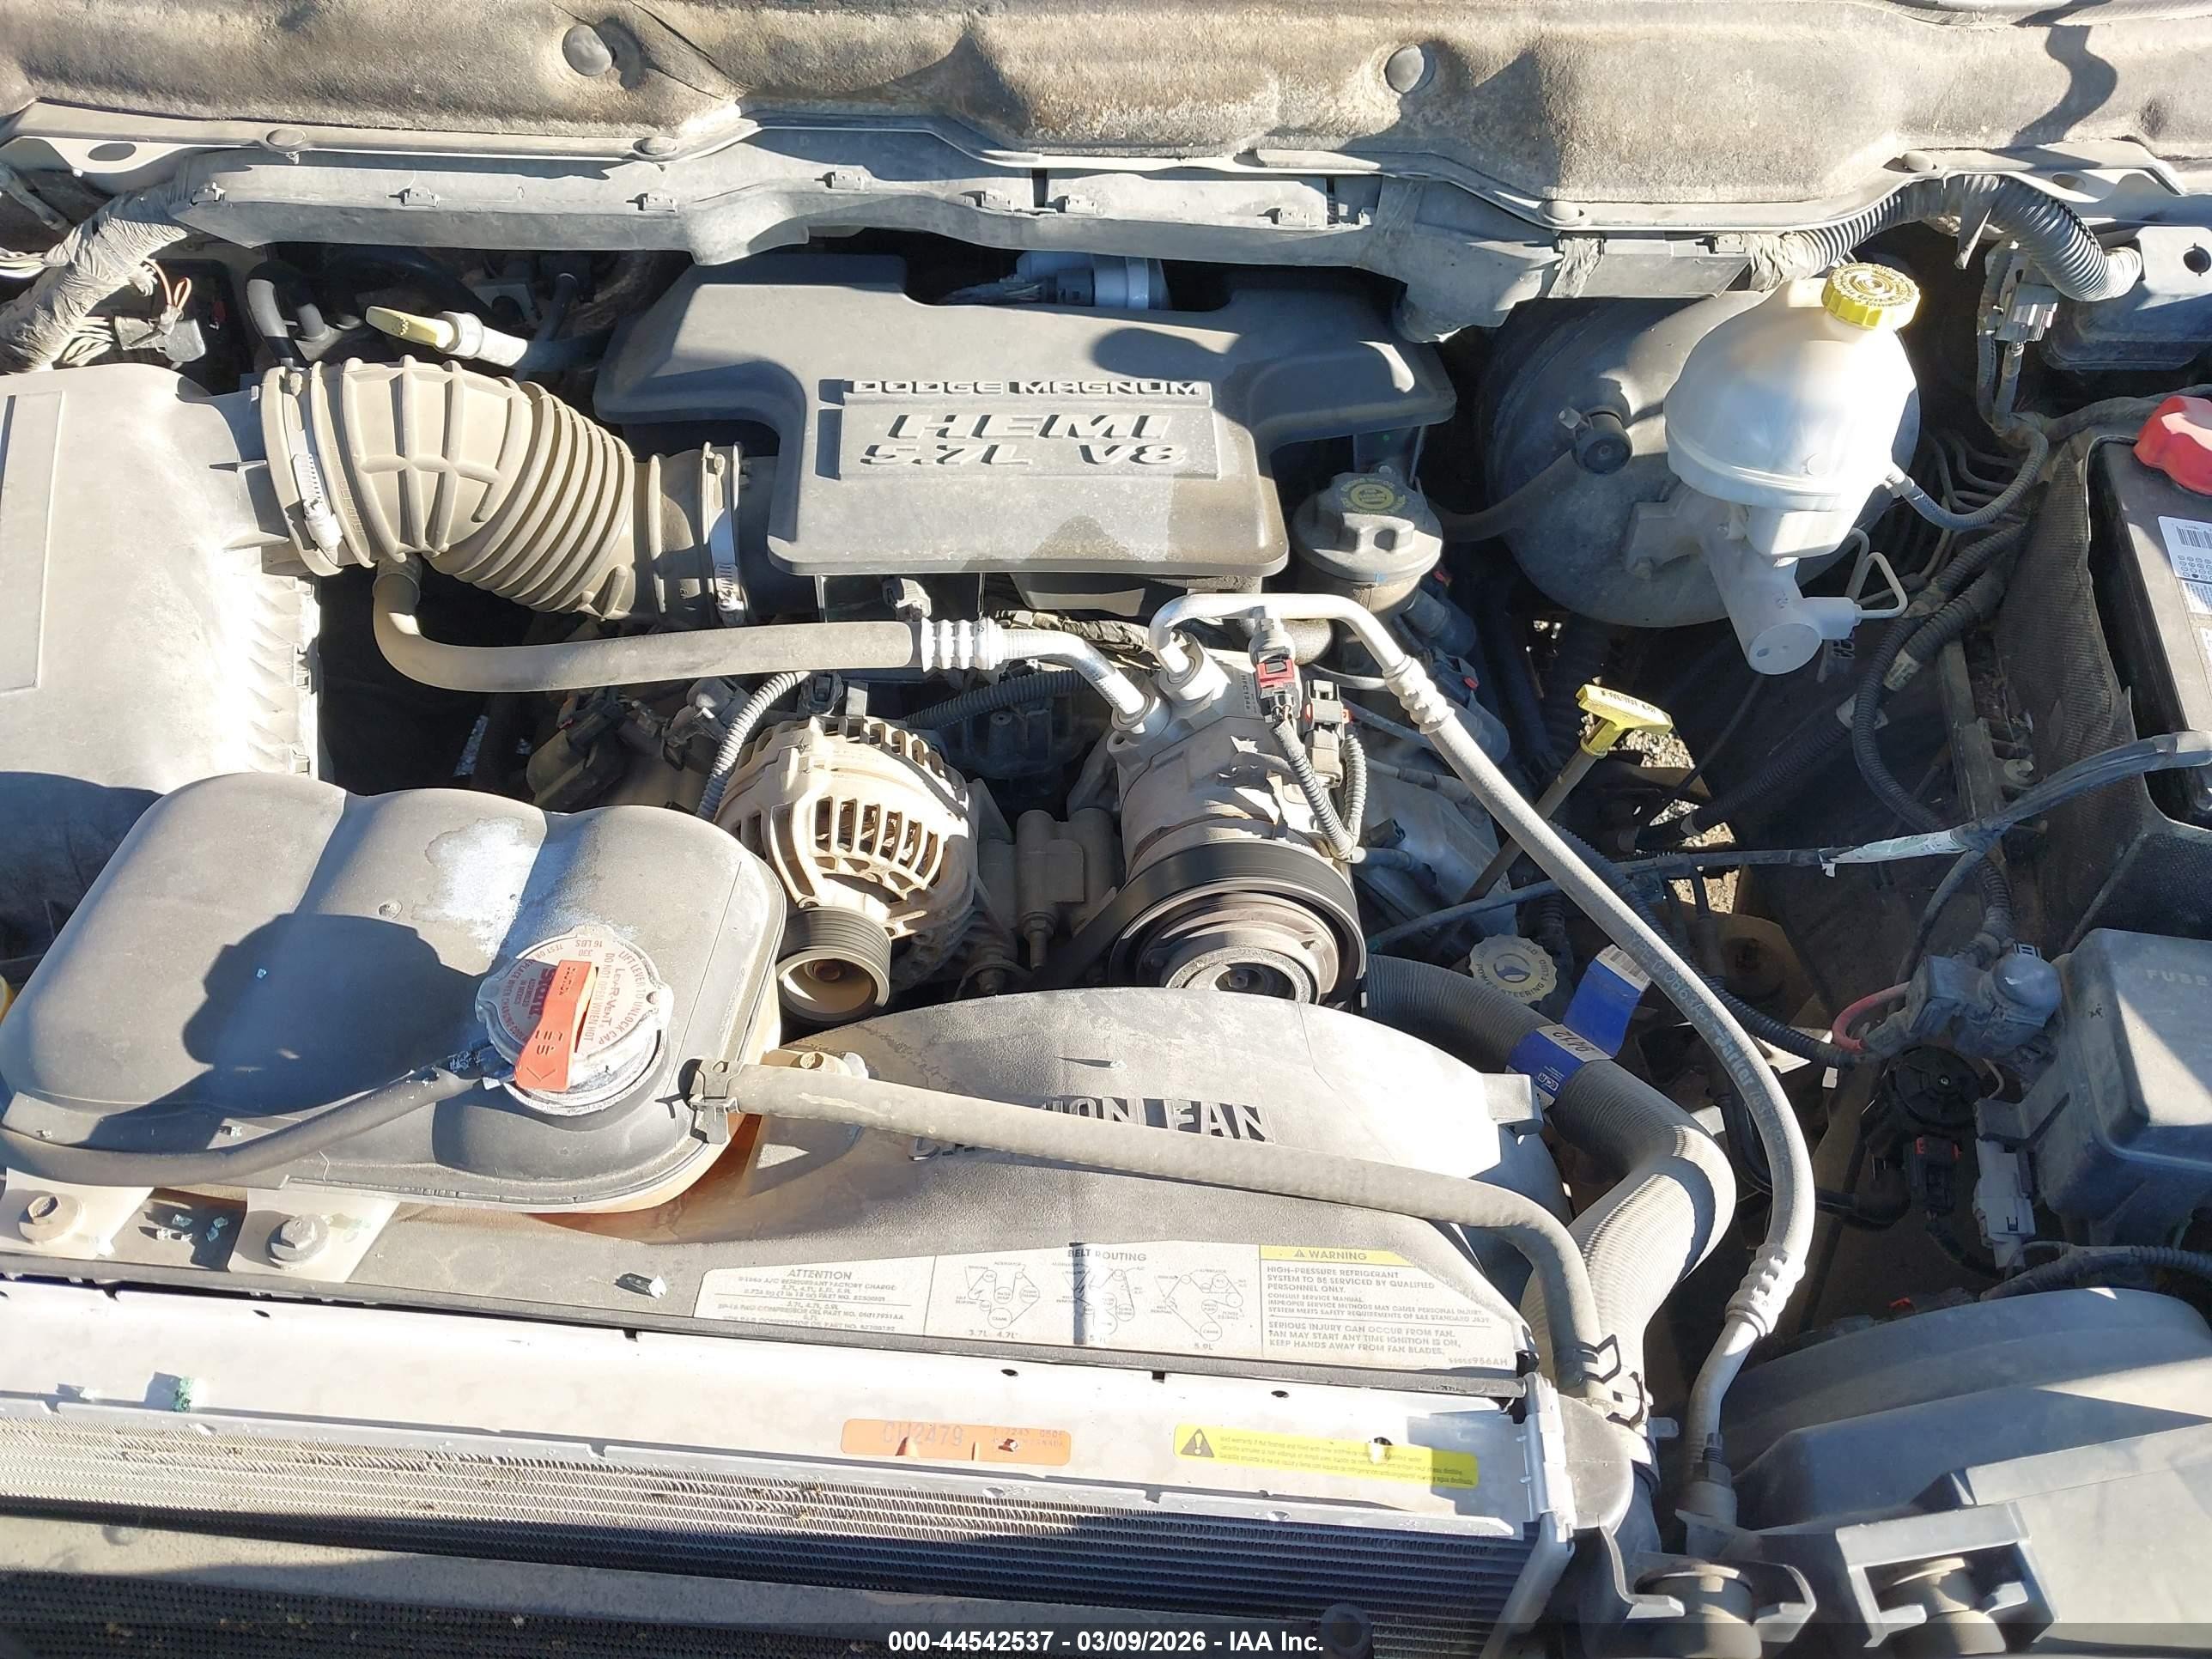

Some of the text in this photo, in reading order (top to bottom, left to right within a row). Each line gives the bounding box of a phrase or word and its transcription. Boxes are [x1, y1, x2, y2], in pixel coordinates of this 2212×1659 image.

[852, 380, 1202, 396] DODGE MAGNUM
[887, 412, 1172, 440] HEMI
[860, 443, 1187, 466] 5.7L V8
[546, 944, 563, 954] TEST
[1501, 983, 1545, 998] STEERING
[1539, 959, 1549, 981] FLUID
[2145, 969, 2209, 987] FUSE
[584, 953, 614, 1041] DO NOT OPEN WHEN HOT
[598, 951, 646, 1043] LIFT LEVER TO UNLOCK CAP
[1164, 1098, 1276, 1145] FAN
[1067, 1249, 1147, 1261] BELT ROUTING
[1309, 1249, 1367, 1261] WARNING
[787, 1269, 852, 1280] ATTENTION
[1267, 1267, 1399, 1279] HIGH-PRESSURE REFRIGERANT
[1267, 1274, 1300, 1283] SYSTEM
[1389, 1280, 1435, 1289] QUALIFIED
[1267, 1283, 1318, 1292] PERSONNEL
[1346, 1310, 1401, 1319] REQUIREMENTS
[1269, 1322, 1306, 1330] SERIOUS
[1309, 1323, 1341, 1332] INJURY
[1368, 1326, 1402, 1334] OCCUR
[1434, 1329, 1455, 1338] FAN.
[1312, 1332, 1340, 1340] START
[1364, 1334, 1384, 1343] TIME
[1387, 1336, 1429, 1345] IGNITION
[1293, 1340, 1327, 1349] HANDS
[1328, 1342, 1355, 1351] AWAY
[1358, 1344, 1385, 1352] FROM
[1408, 1346, 1444, 1355] BLADES.
